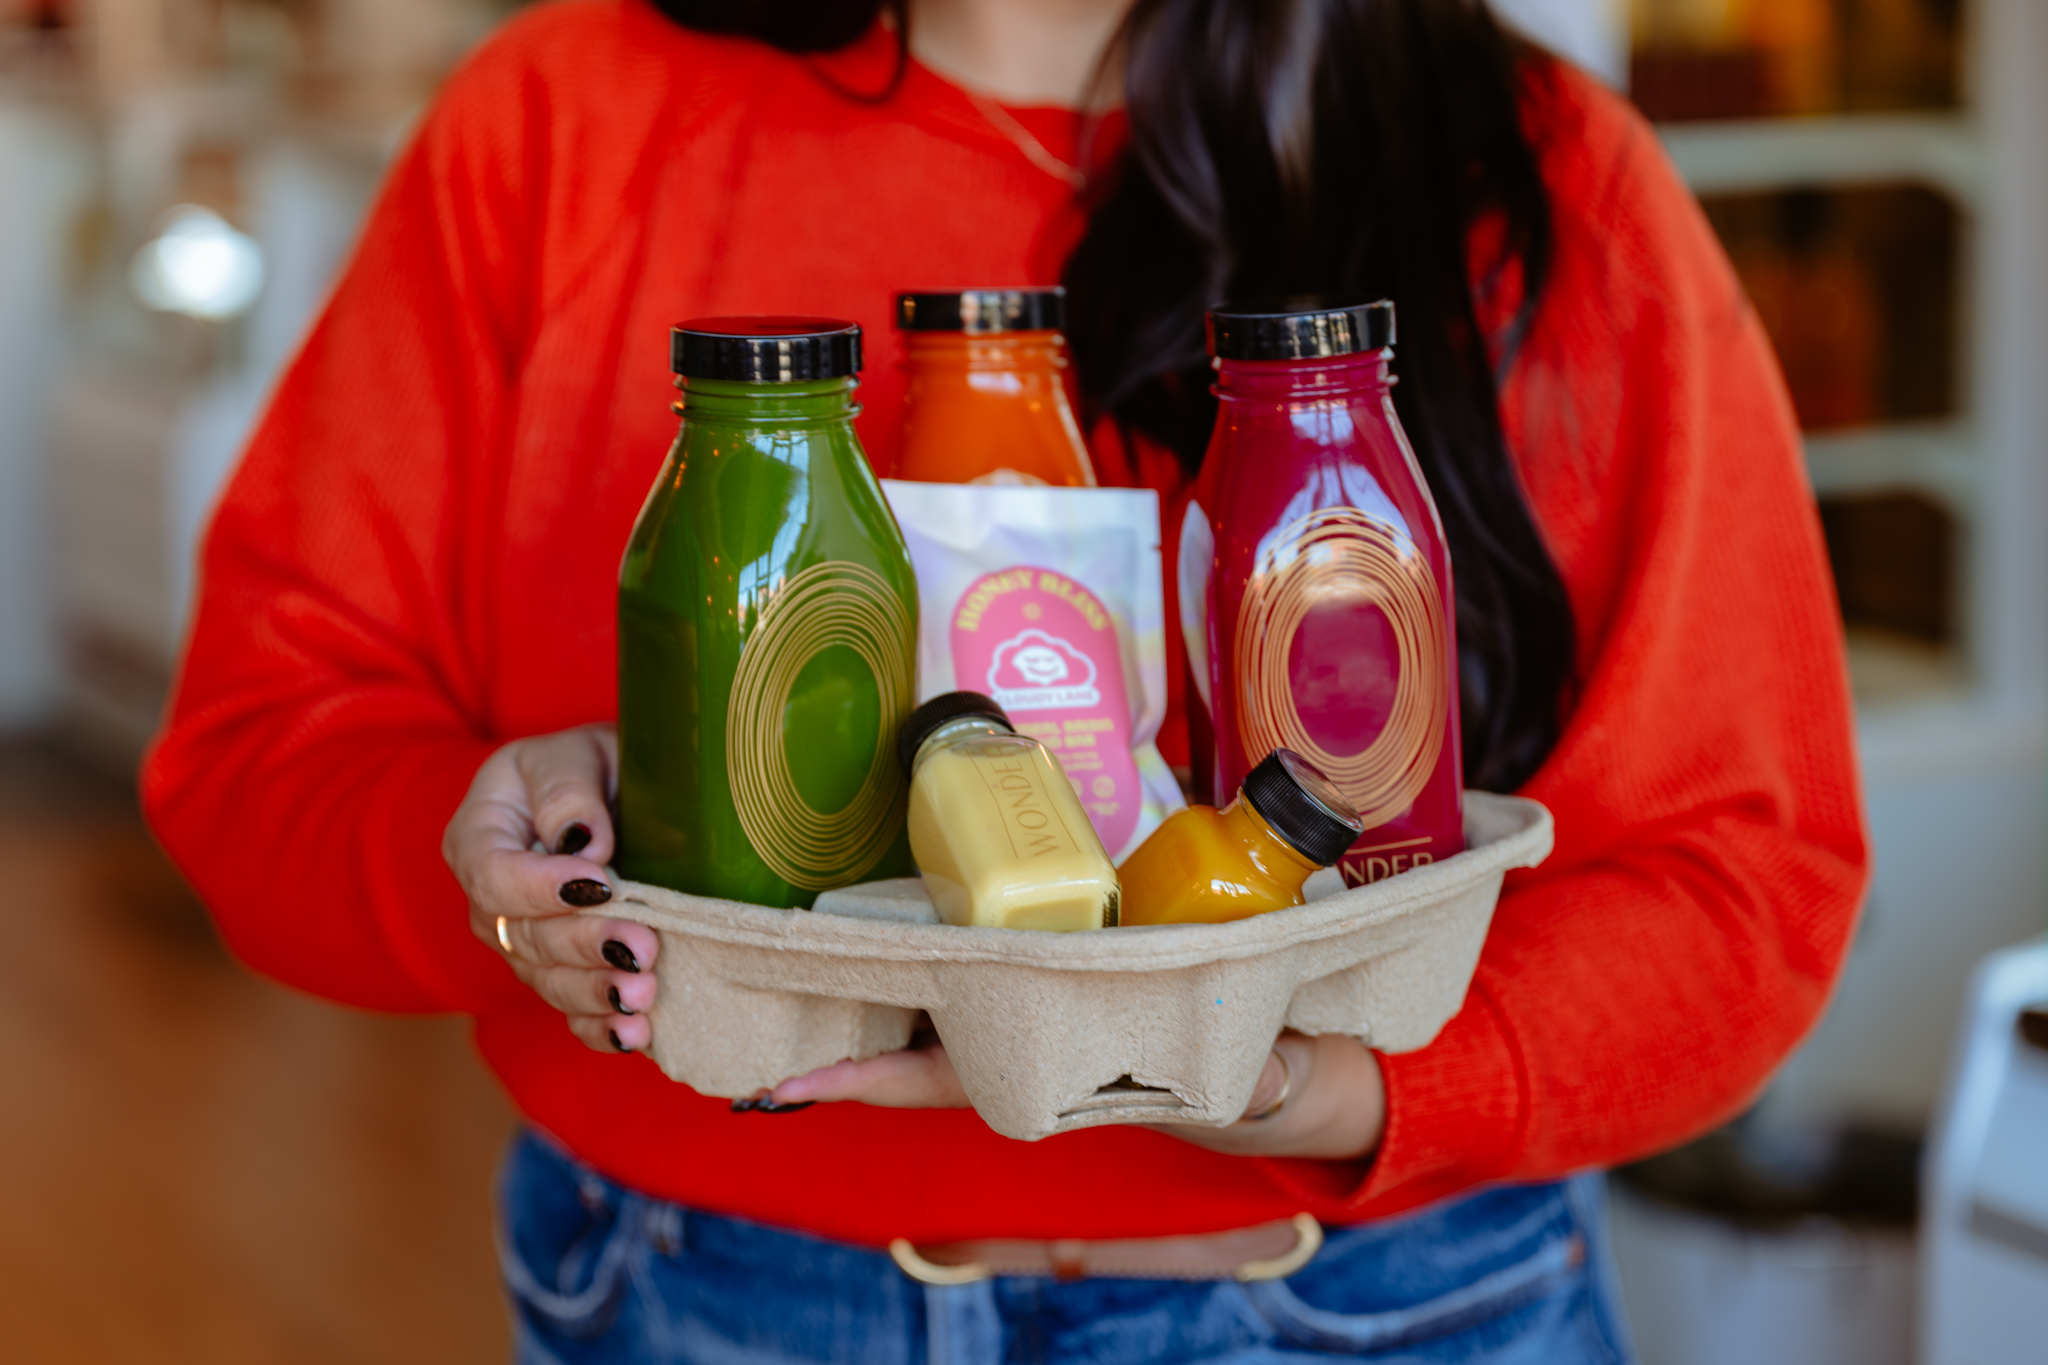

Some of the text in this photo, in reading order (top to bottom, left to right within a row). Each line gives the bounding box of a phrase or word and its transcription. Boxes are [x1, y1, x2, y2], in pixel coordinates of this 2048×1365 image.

[956, 569, 1110, 632] HONEY BLISS
[981, 743, 1062, 857] WONDER
